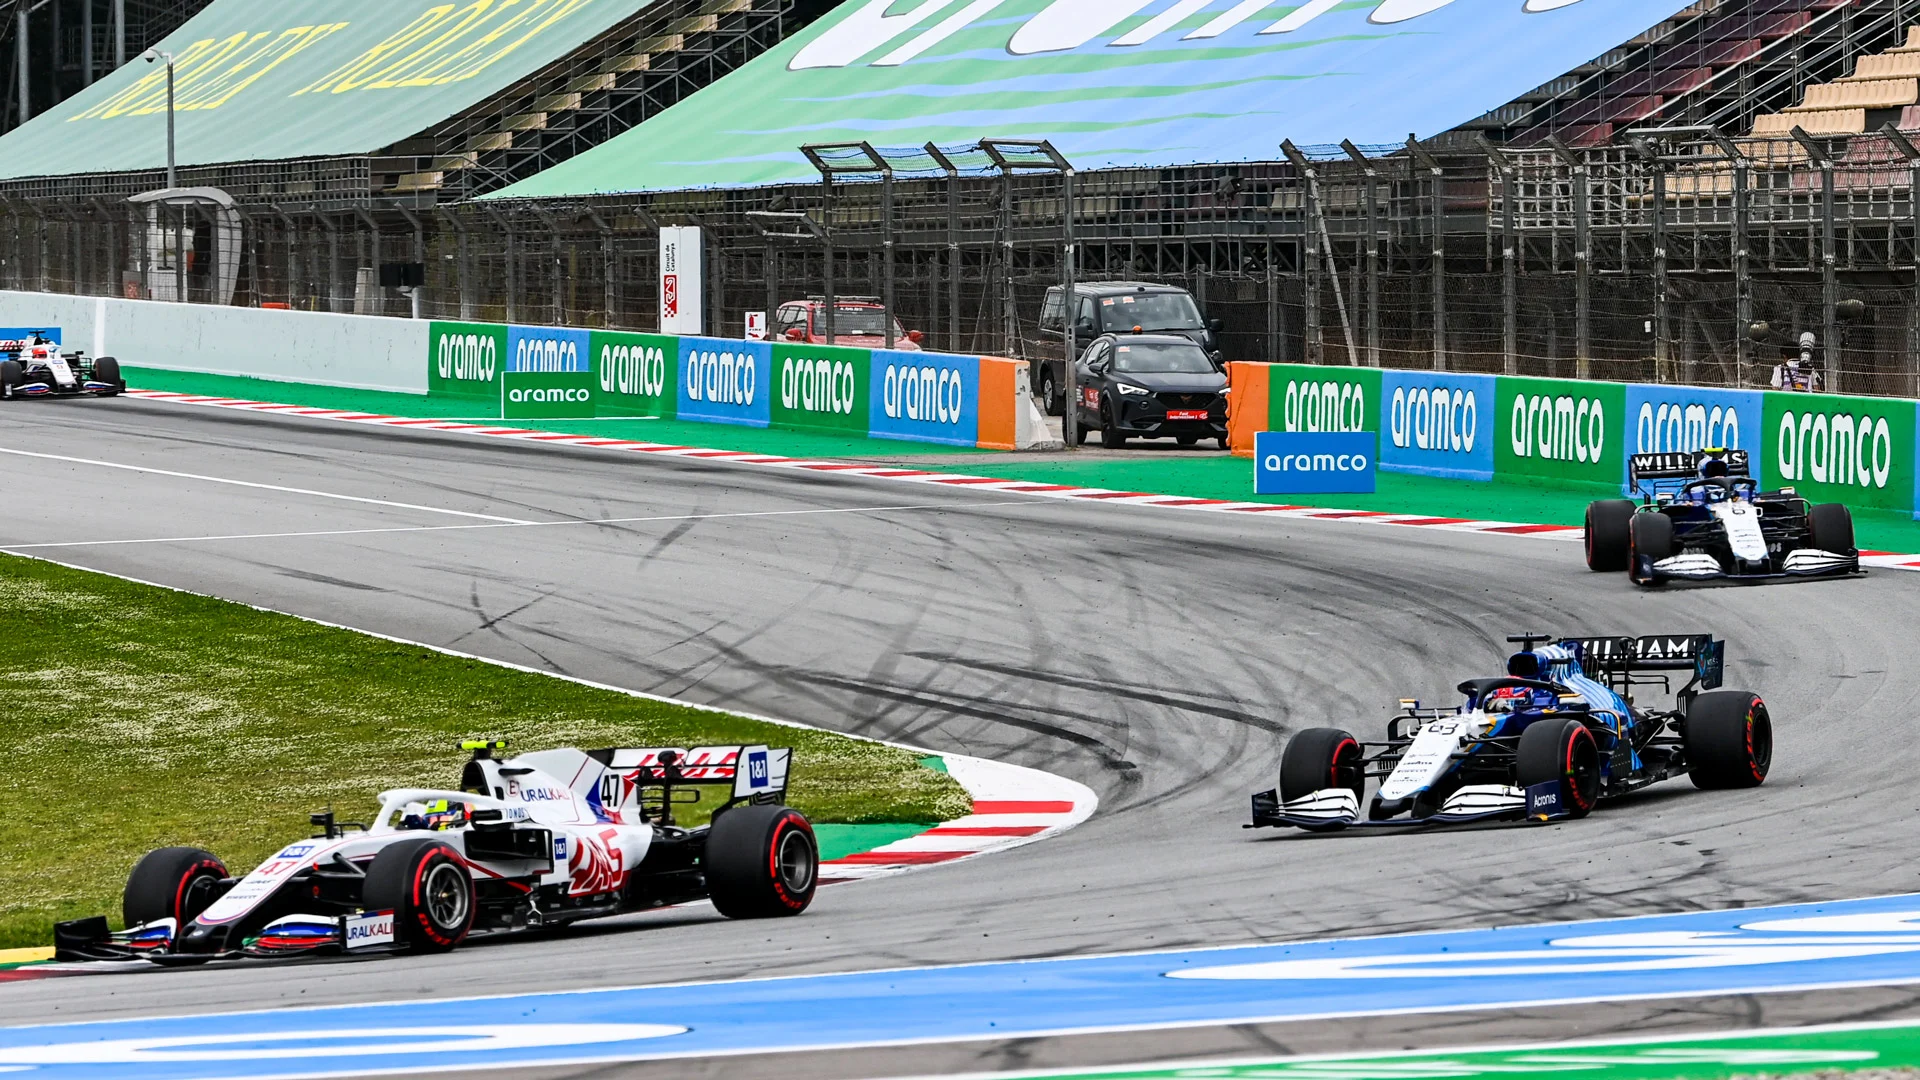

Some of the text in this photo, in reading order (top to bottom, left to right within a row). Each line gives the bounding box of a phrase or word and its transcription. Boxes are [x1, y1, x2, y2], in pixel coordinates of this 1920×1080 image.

[65, 22, 349, 122] ROLEX
[438, 333, 496, 382] aramco
[516, 338, 577, 372] aramco
[599, 343, 665, 397] aramco
[686, 350, 755, 406] aramco
[509, 388, 590, 402] aramco
[781, 357, 855, 415] aramco
[883, 364, 962, 424] aramco
[1284, 380, 1364, 432] aramco
[1390, 386, 1477, 453] aramco
[1511, 393, 1604, 464] aramco
[1637, 401, 1739, 454] aramco
[1264, 454, 1367, 471] aramco
[1778, 410, 1891, 488] aramco
[601, 773, 620, 808] 47
[751, 759, 767, 780] 1&1
[1533, 793, 1557, 808] Acronis
[257, 861, 299, 876] 47
[346, 921, 394, 941] URALKALI
